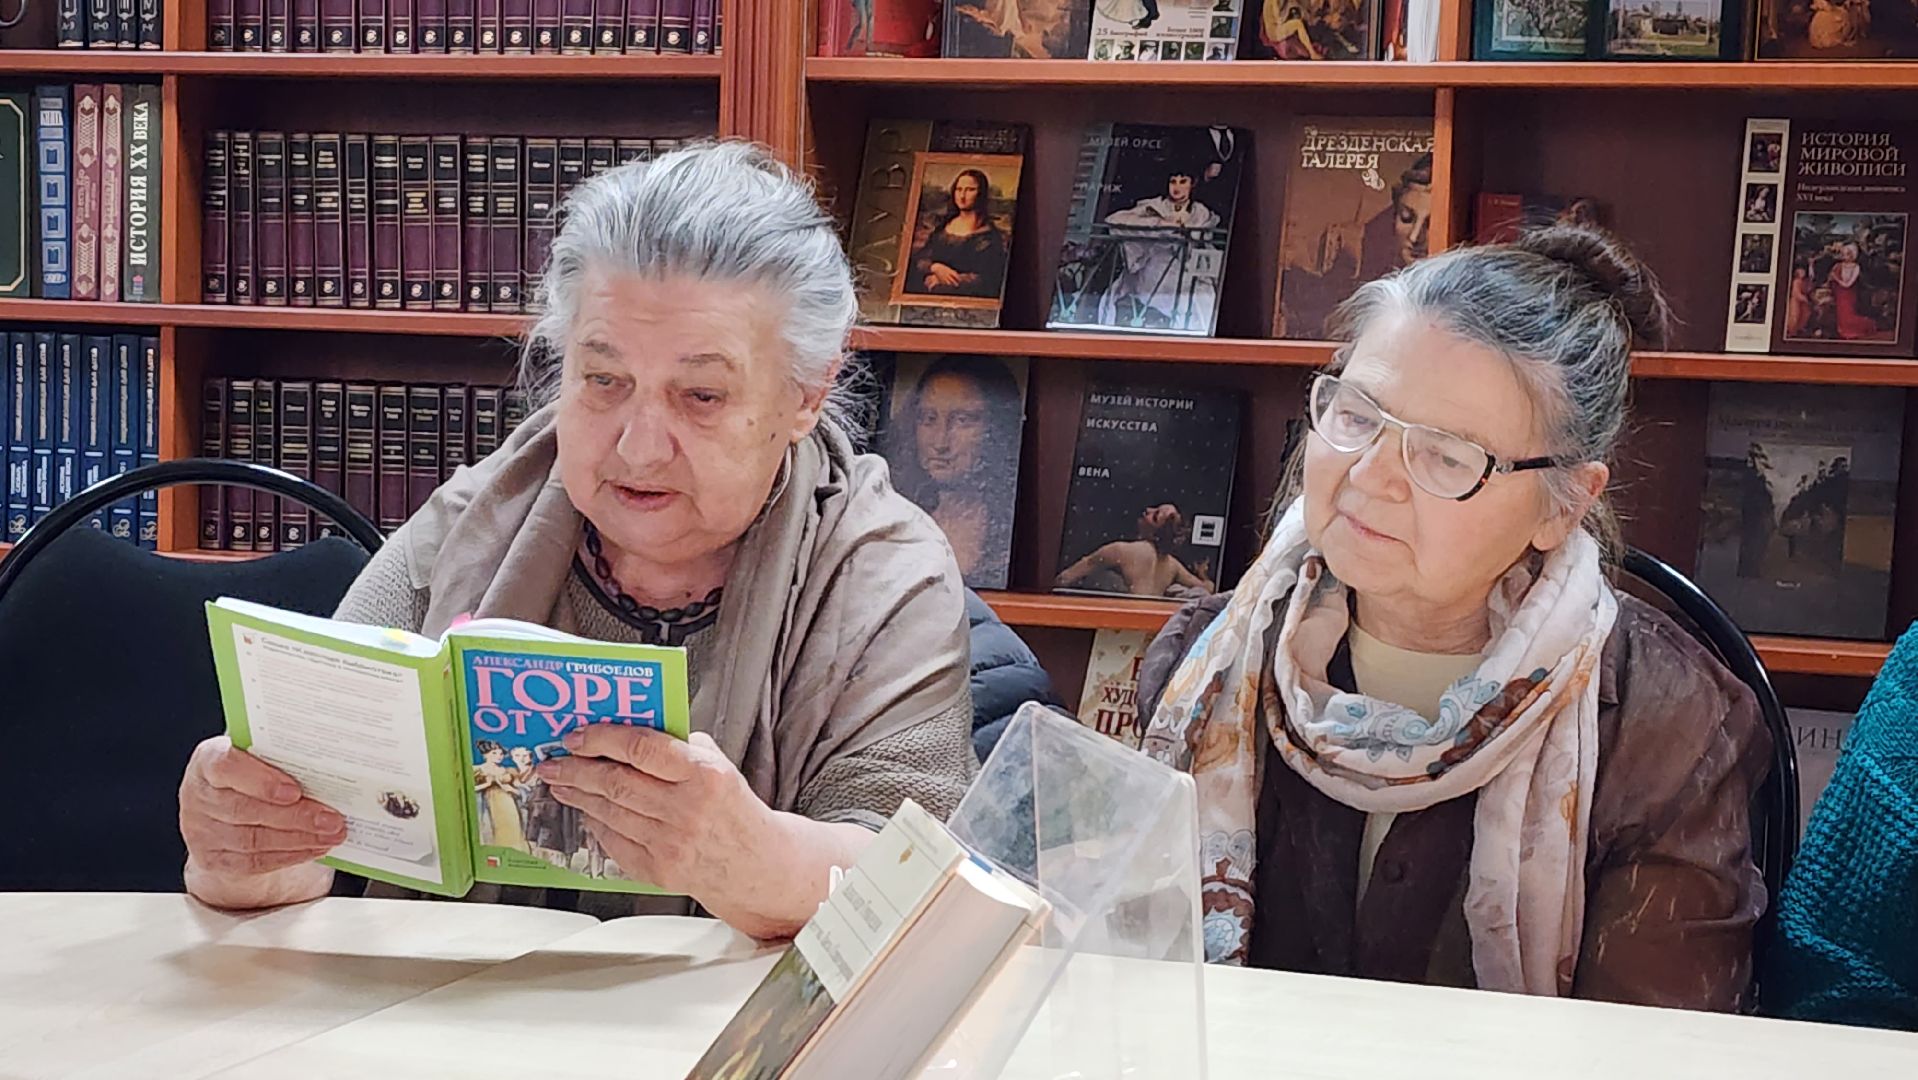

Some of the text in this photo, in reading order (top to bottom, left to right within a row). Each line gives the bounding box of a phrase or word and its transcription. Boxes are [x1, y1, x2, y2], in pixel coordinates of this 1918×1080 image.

[133, 101, 149, 140] ВЕКА
[1301, 135, 1435, 153] ДРЕЗДЕНСКАЯ
[1801, 132, 1890, 146] ИСТОРИЯ
[1301, 152, 1379, 169] ГАЛЕРЕЯ
[1800, 146, 1899, 161] МИРОВОЙ
[1798, 162, 1906, 176] ЖИВОПИСИ
[130, 175, 148, 266] ИСТОРИЯ
[1090, 393, 1194, 410] МУЗЕЙ ИСТОРИИ
[1086, 418, 1158, 433] ИСКУССТВА
[1078, 466, 1110, 479] ВЕНА
[473, 656, 654, 678] АЛЕКСАНДР ГРИБОЕДОВ
[473, 666, 655, 719] ГОРЕ
[1101, 686, 1139, 708] ХУД
[473, 707, 533, 735] ОТ
